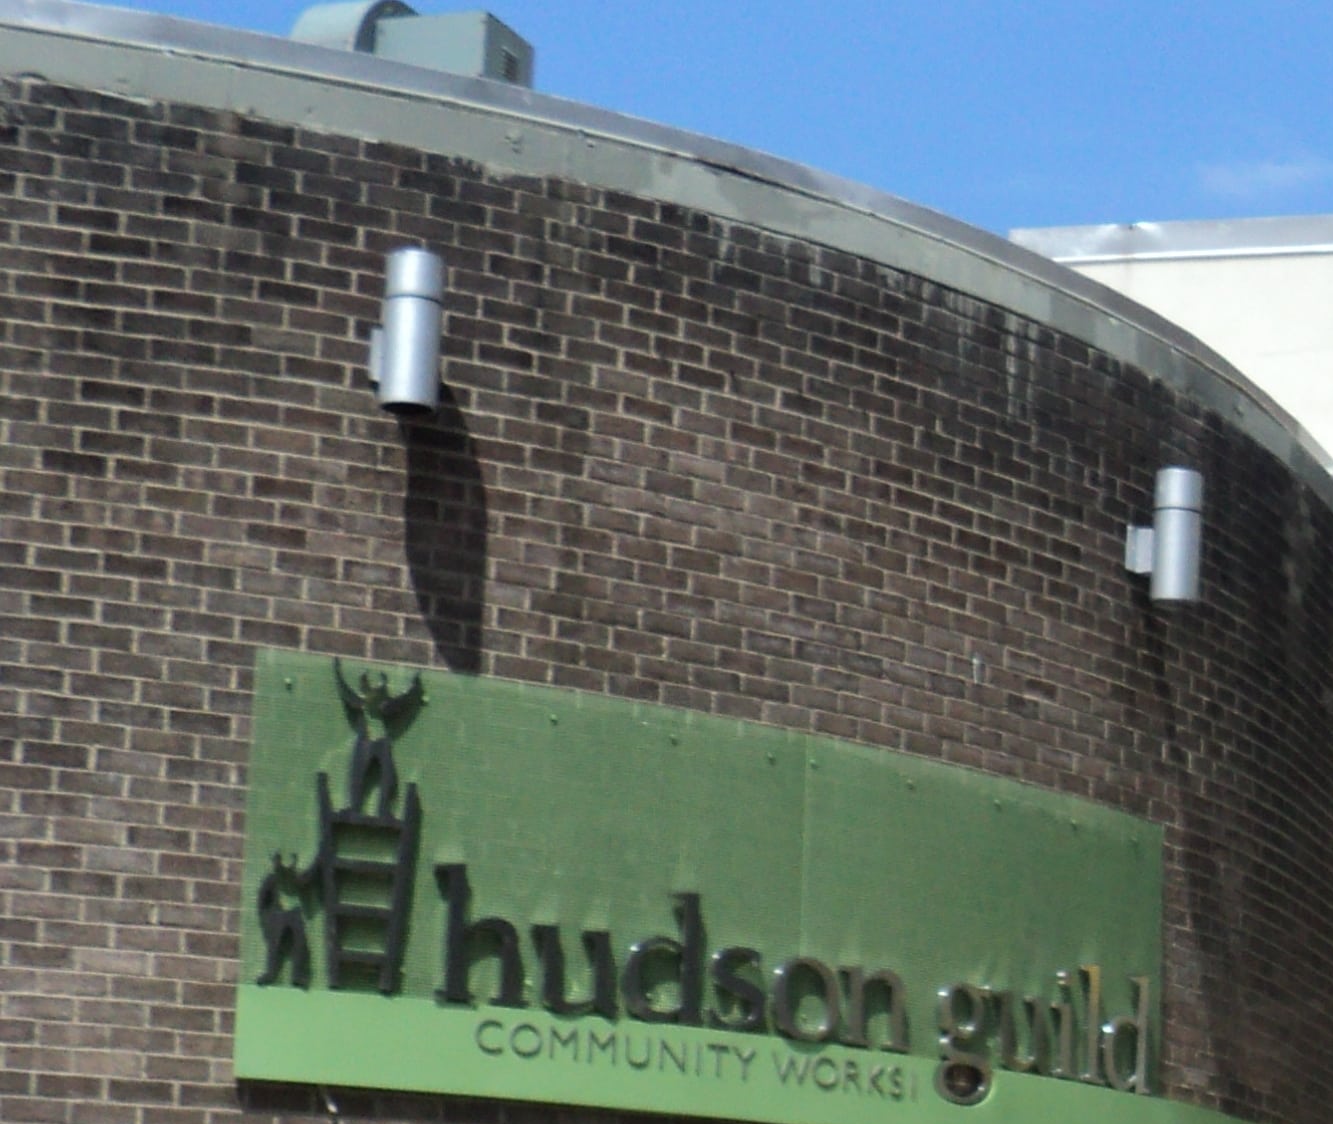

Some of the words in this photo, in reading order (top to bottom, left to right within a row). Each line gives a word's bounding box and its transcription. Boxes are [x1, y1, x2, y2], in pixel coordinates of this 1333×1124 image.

[432, 862, 912, 1056] hudson
[934, 964, 1151, 1106] guild
[475, 1018, 756, 1082] COMMUNITY
